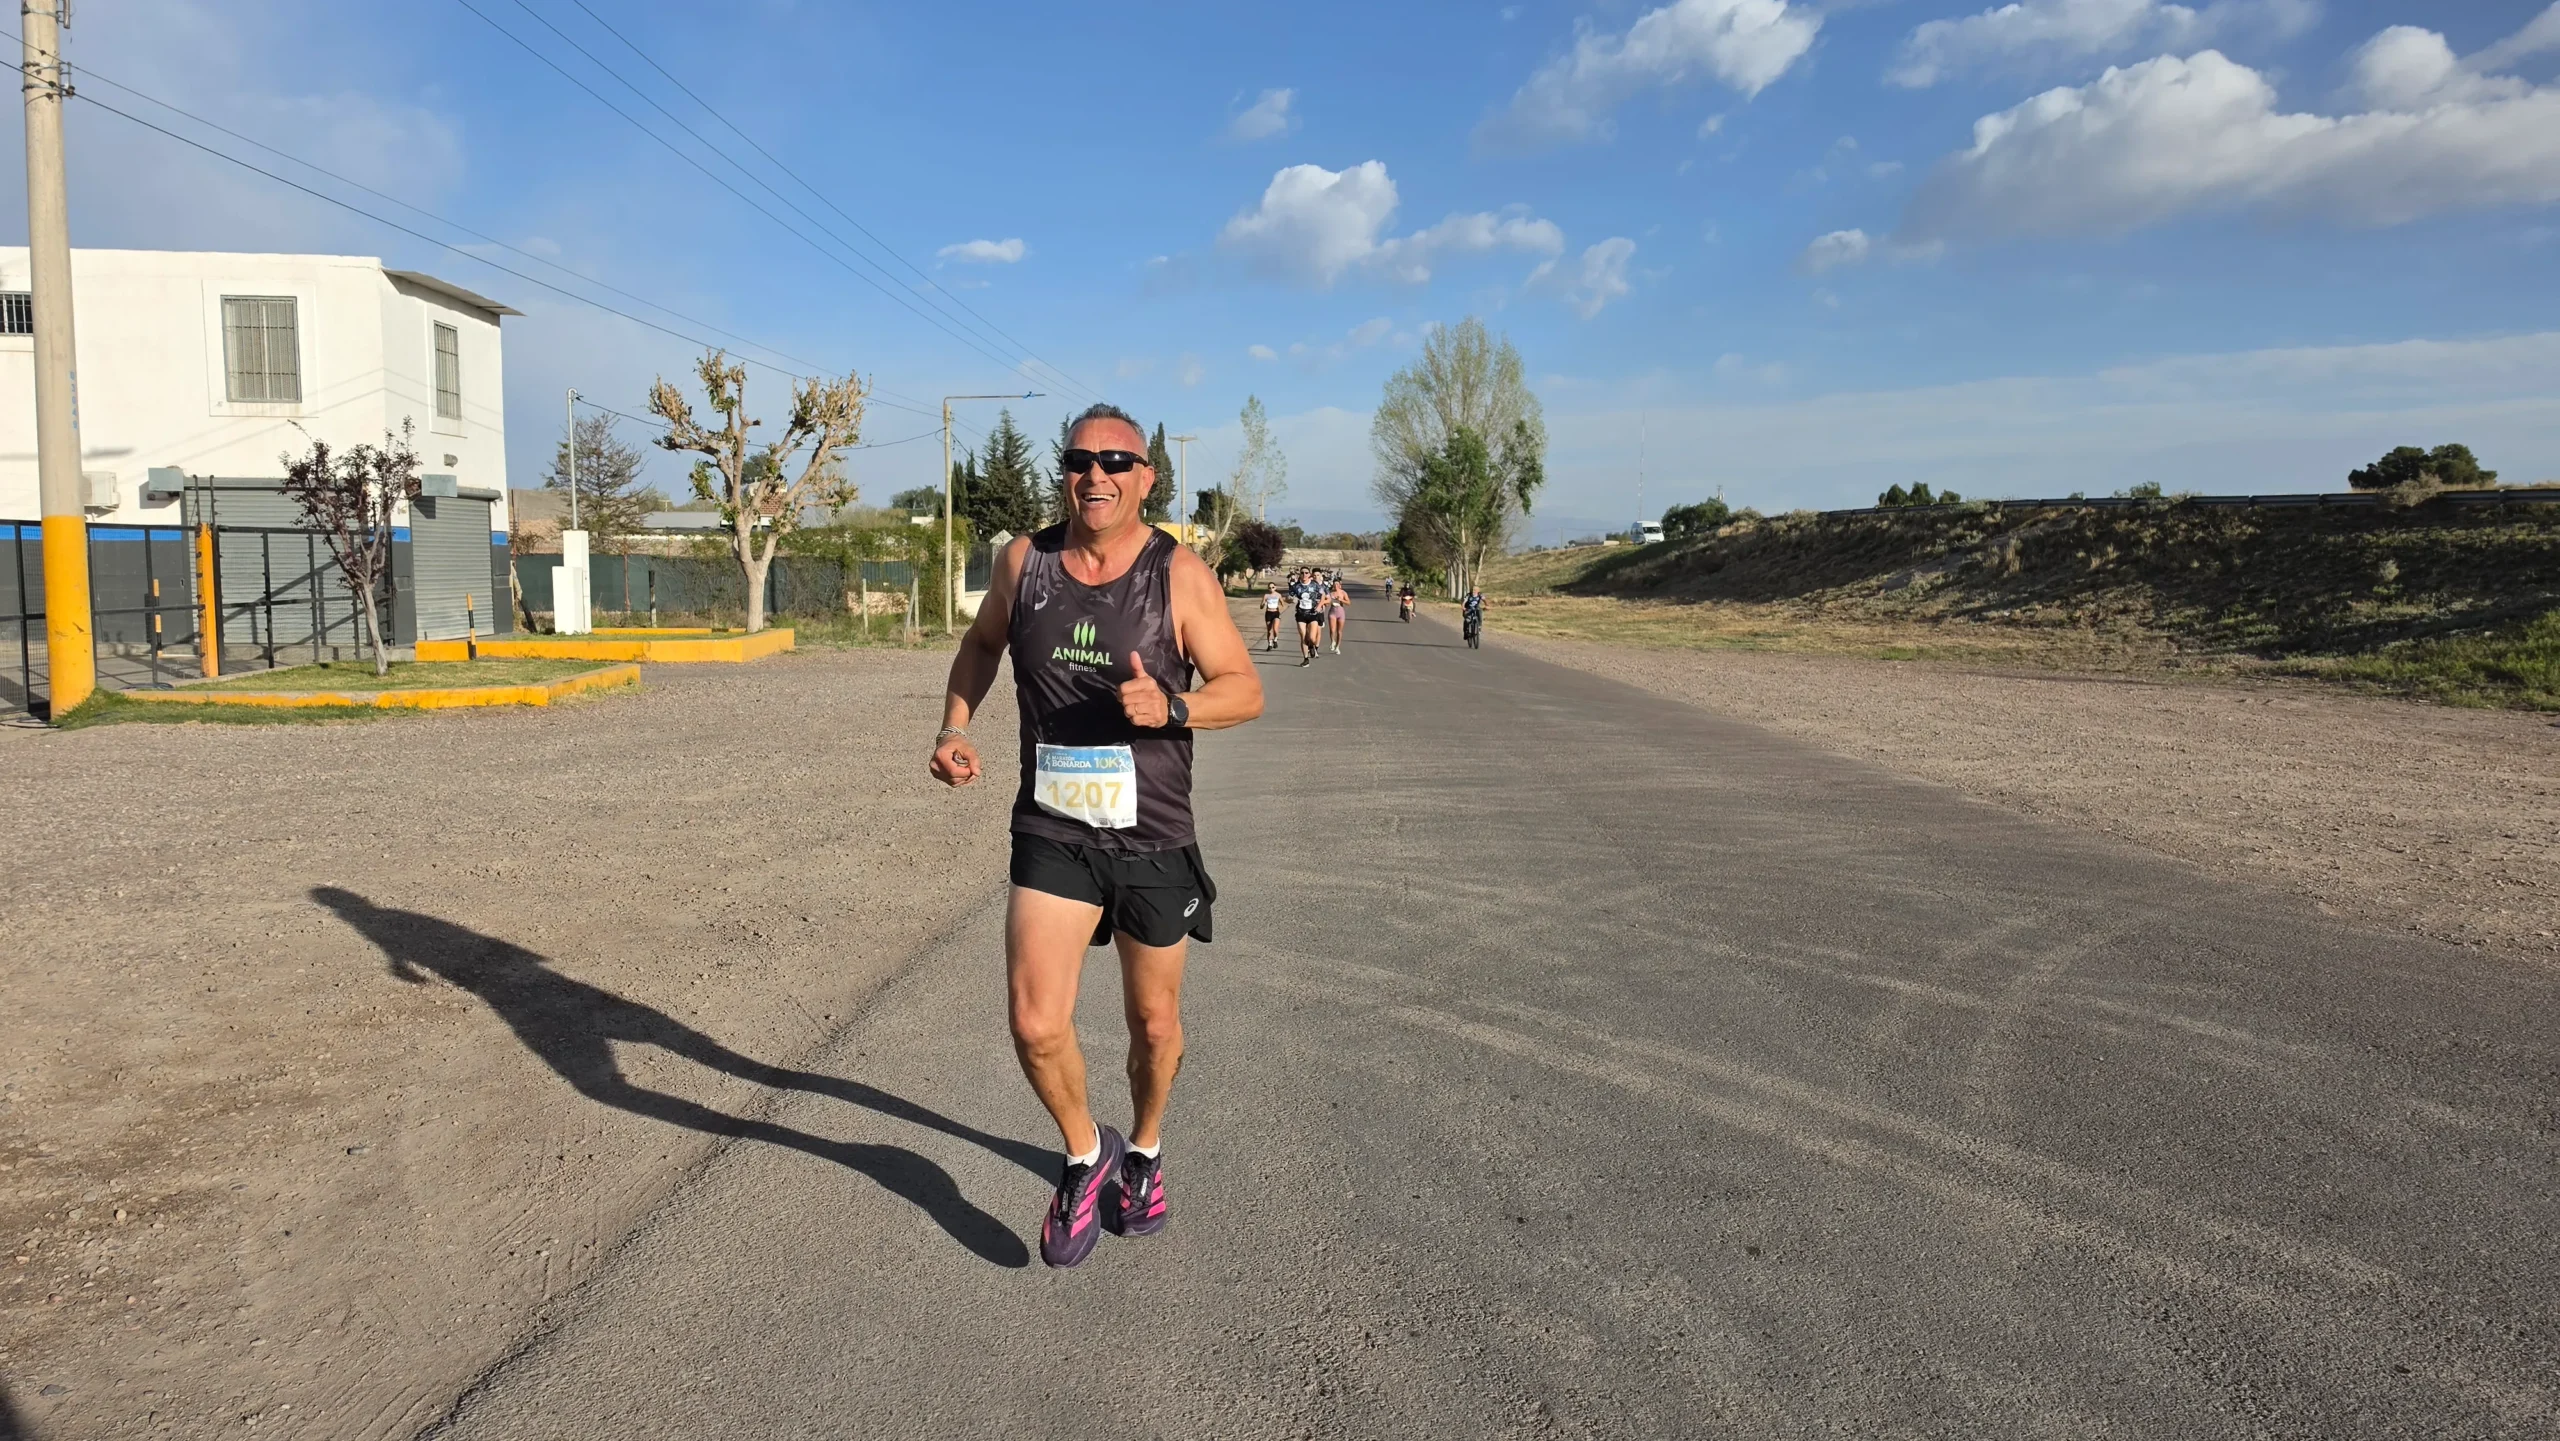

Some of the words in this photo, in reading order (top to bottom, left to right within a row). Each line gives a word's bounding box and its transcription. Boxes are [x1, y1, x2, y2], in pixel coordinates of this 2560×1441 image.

[1052, 647, 1113, 665] ANIMAL
[1069, 662, 1097, 673] fitness
[1052, 760, 1092, 768] BONARDA
[1094, 757, 1119, 769] 10K
[1047, 781, 1123, 808] 1207
